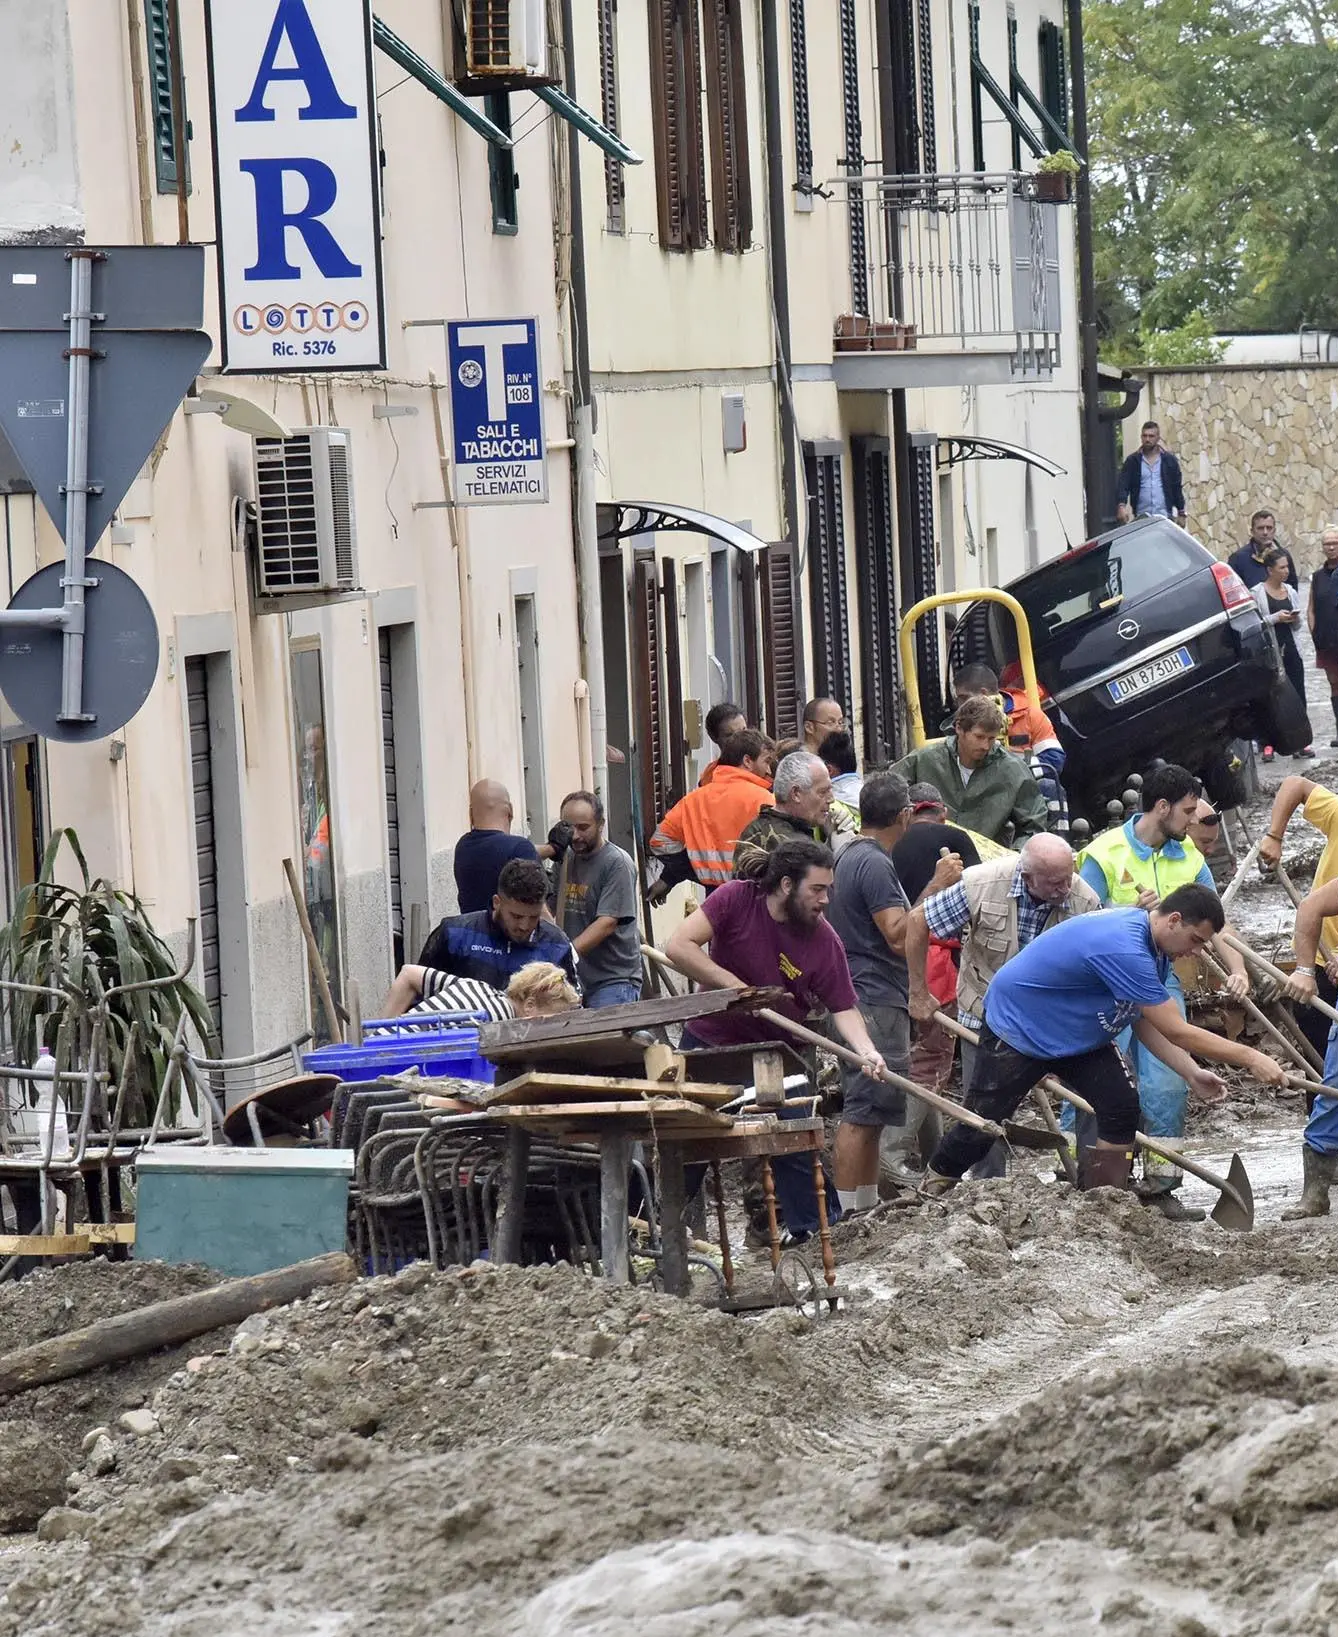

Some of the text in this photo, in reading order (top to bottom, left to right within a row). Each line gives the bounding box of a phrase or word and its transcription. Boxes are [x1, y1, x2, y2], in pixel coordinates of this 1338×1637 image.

[240, 305, 362, 332] LOTTO
[272, 340, 336, 356] Ric. 5376
[457, 324, 528, 422] T
[506, 373, 522, 384] RIV.
[509, 387, 530, 401] 108
[477, 424, 520, 439] SALI E
[461, 438, 538, 460] TABACCHI
[476, 464, 527, 480] SERVIZI
[465, 480, 540, 497] TELEMATICI
[1118, 654, 1183, 695] DN 873DH
